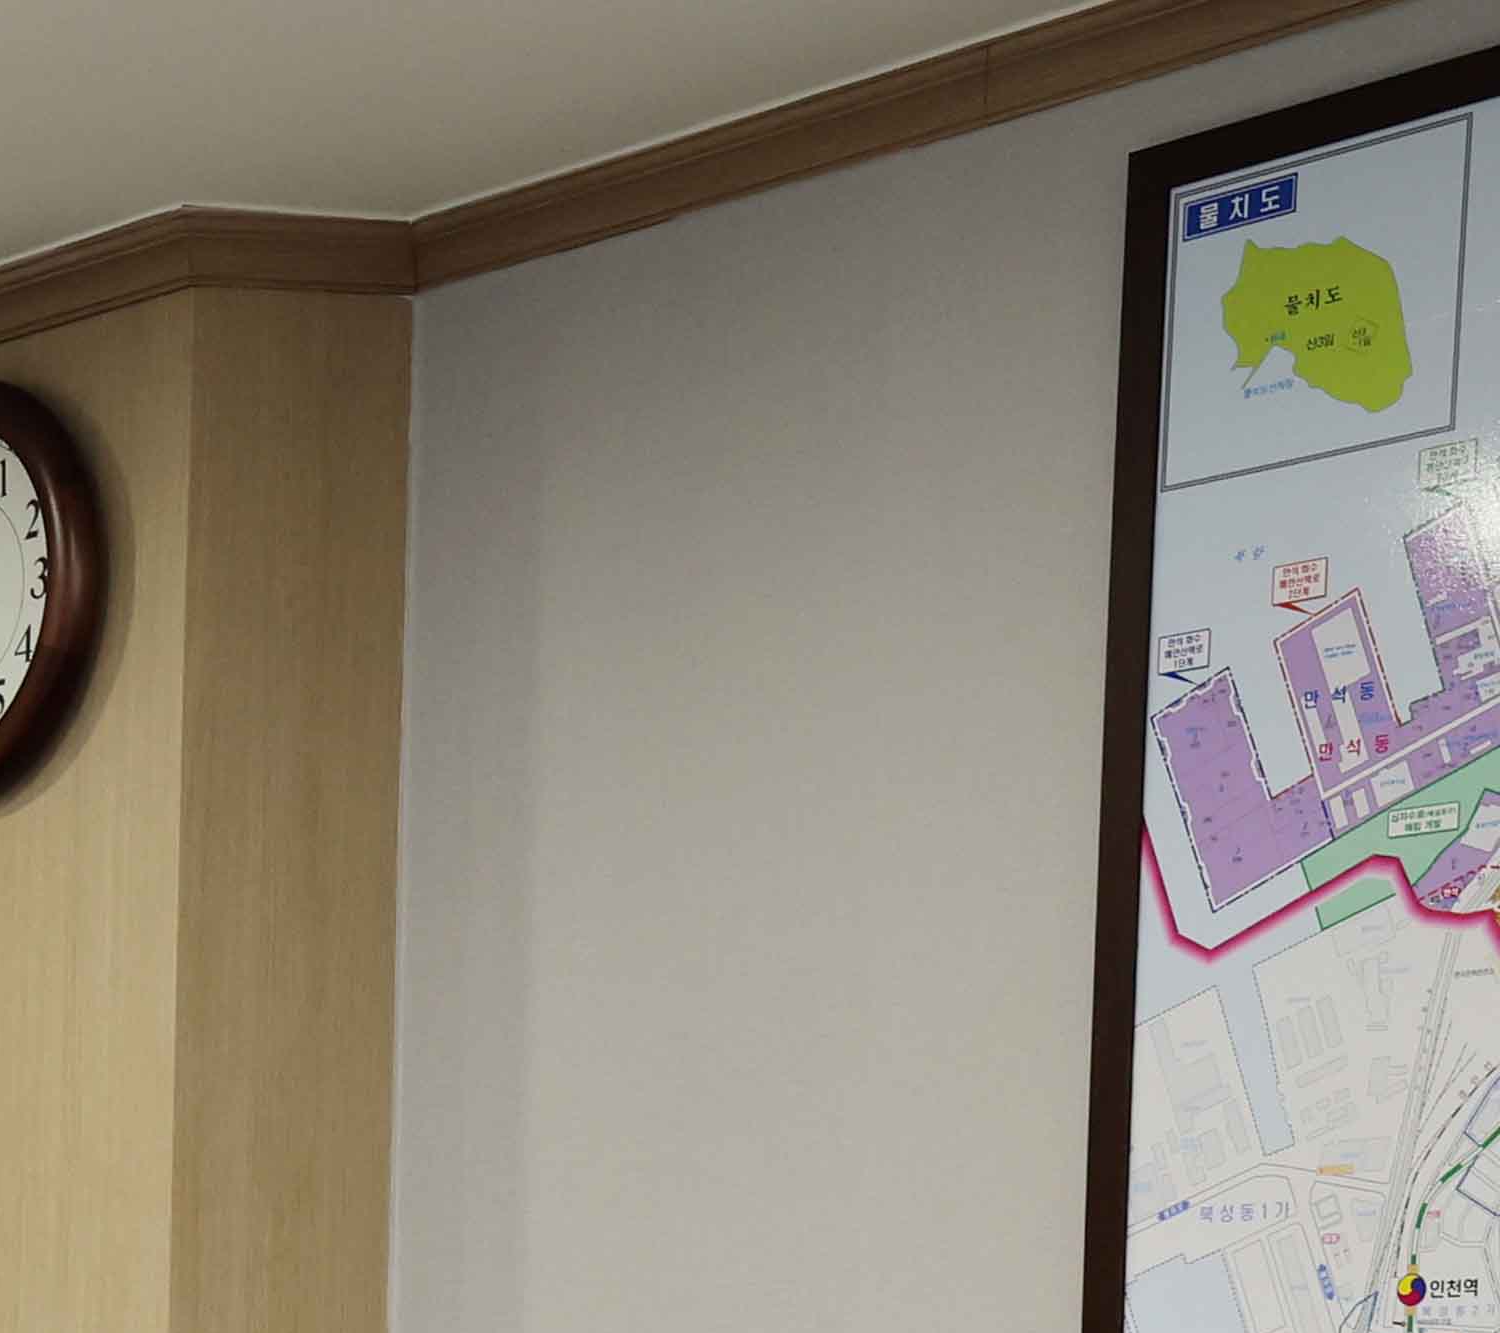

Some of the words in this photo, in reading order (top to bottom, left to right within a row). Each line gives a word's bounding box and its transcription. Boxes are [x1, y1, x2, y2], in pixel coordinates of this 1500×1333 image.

[0, 459, 8, 497] 1
[25, 500, 39, 540] 2
[30, 557, 48, 599] 3
[15, 624, 33, 662] 4
[1430, 1279, 1478, 1298] 인천역
